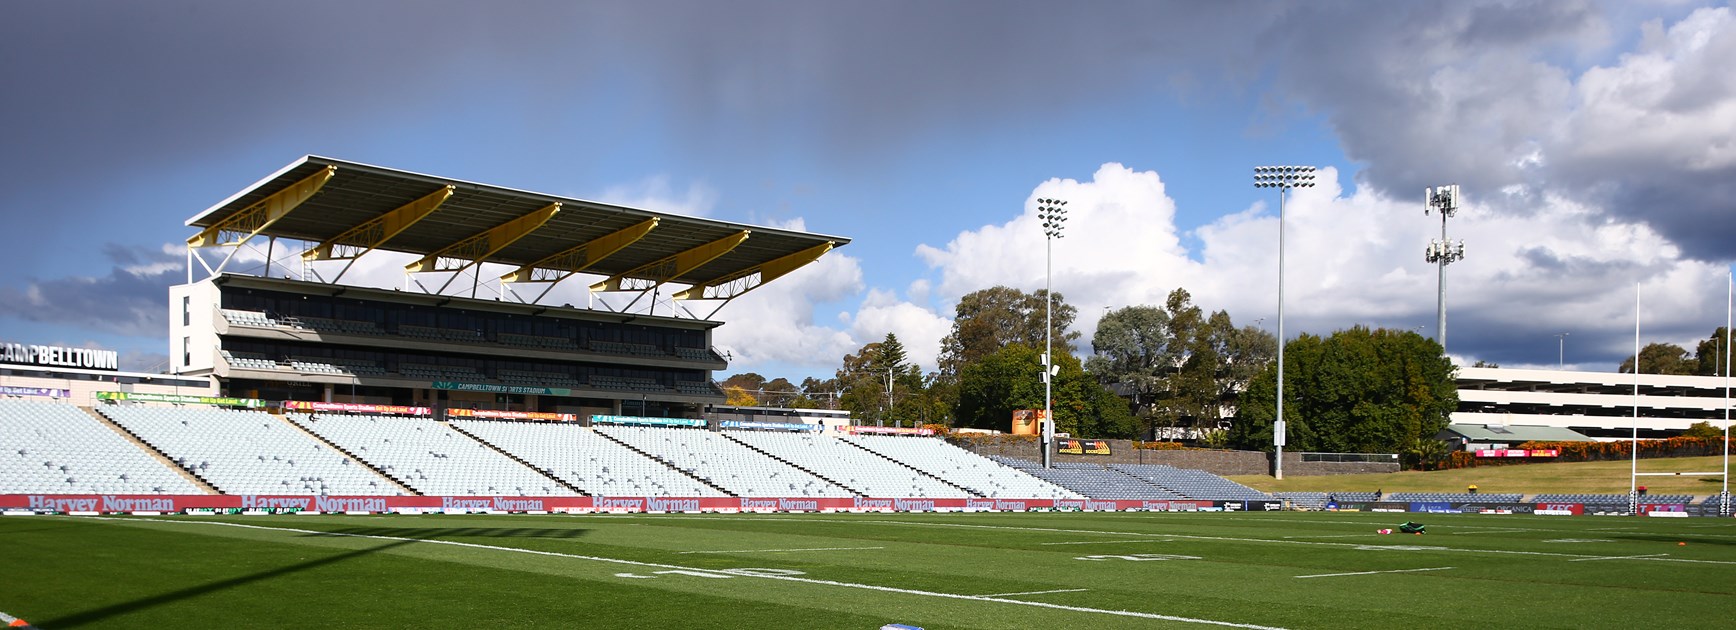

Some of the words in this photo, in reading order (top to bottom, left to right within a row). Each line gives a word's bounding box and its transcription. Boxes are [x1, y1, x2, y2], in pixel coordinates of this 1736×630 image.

[458, 383, 501, 391] CAMPBELLTOWN
[28, 495, 98, 511] Harvey
[102, 495, 174, 511] Norman
[241, 495, 310, 508] Harvey
[315, 495, 386, 512] Norman
[442, 496, 491, 508] Harvey
[493, 496, 543, 511] Norman
[592, 496, 643, 508] Harvey
[646, 496, 700, 511] Norman
[740, 497, 777, 508] Harvey
[779, 498, 818, 510] Norman
[853, 497, 892, 508] Harvey
[894, 497, 935, 511] Norman
[966, 498, 995, 508] Harvey
[995, 498, 1026, 510] Norman
[1053, 499, 1084, 509] Harvey
[1084, 499, 1117, 510] Norman
[1142, 500, 1168, 510] Harvey
[1169, 500, 1197, 510] Norman
